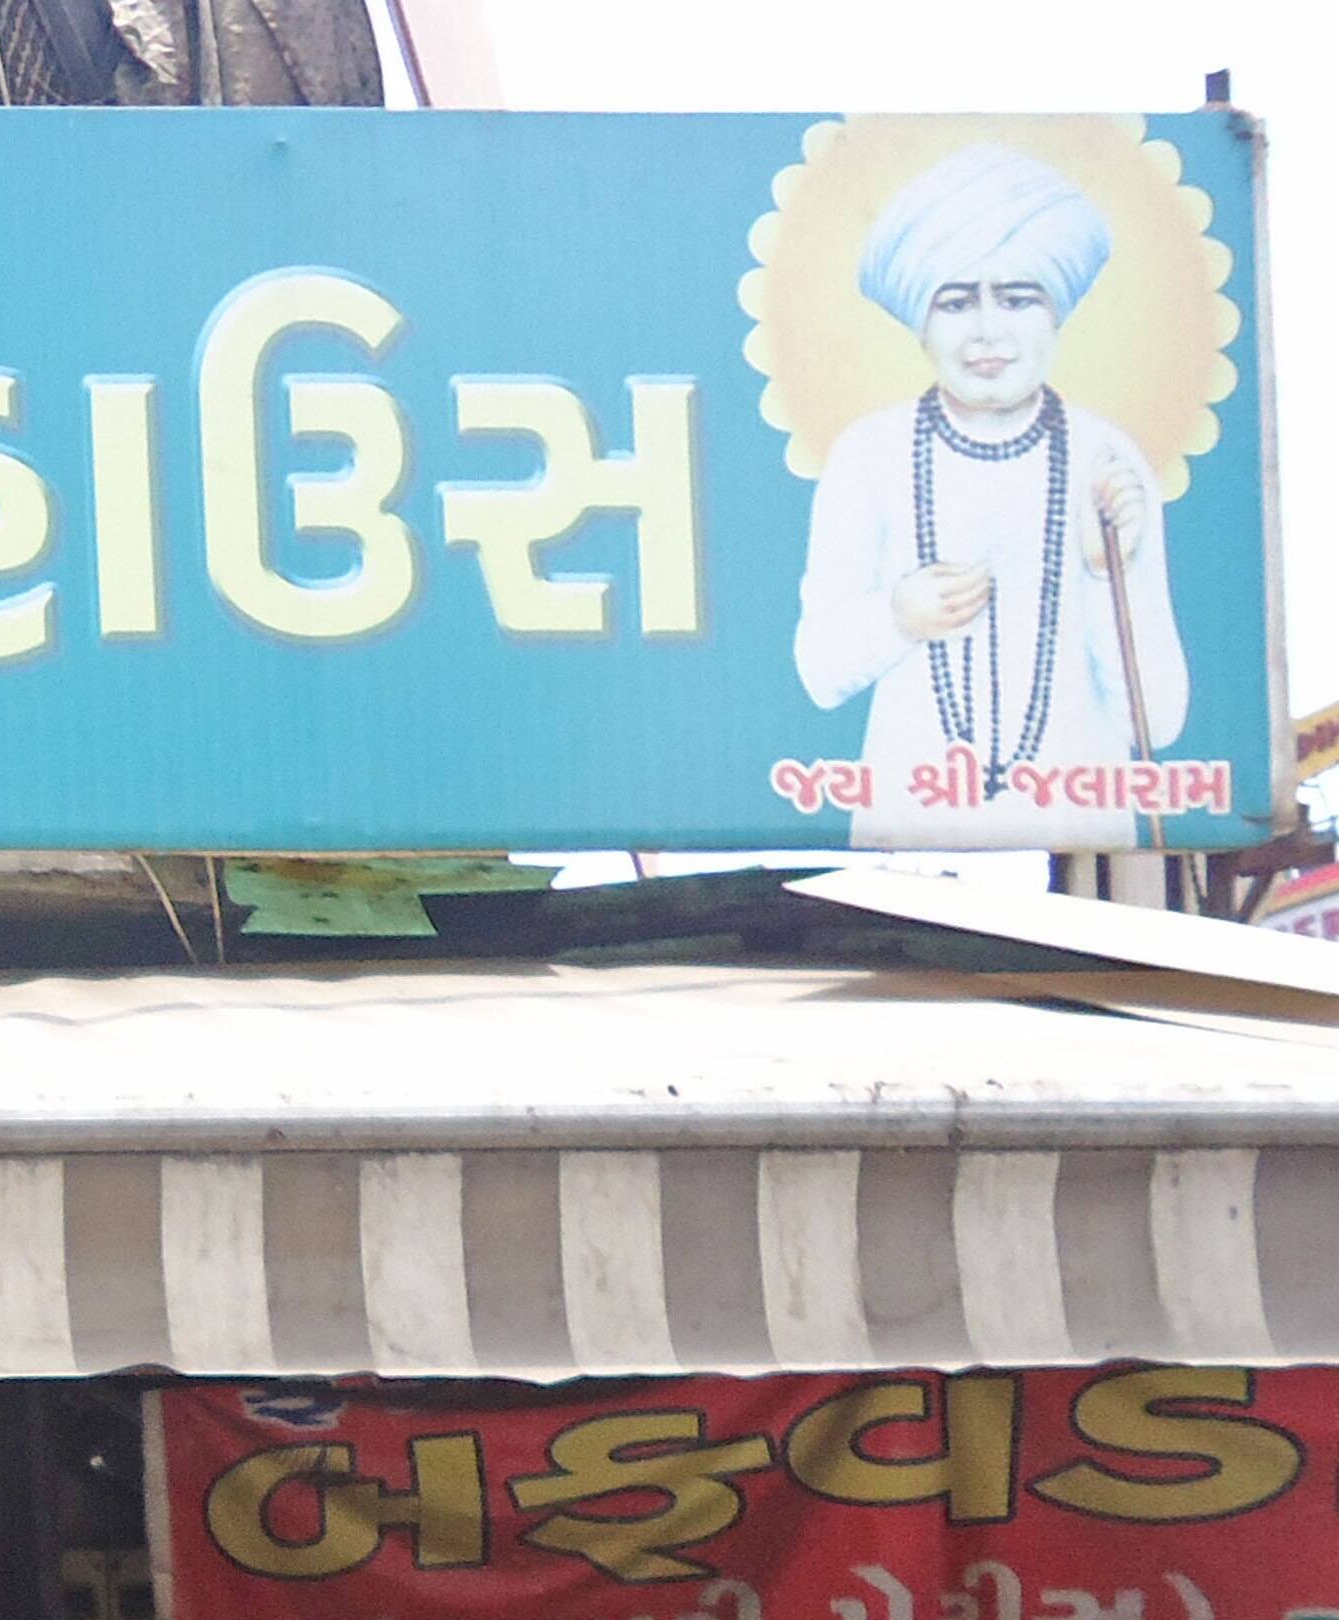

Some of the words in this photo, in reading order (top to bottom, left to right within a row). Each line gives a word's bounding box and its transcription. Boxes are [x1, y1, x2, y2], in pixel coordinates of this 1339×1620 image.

[773, 760, 875, 813] જય
[908, 741, 983, 808] શ્રી
[1010, 760, 1231, 815] જલારામ
[207, 1366, 1339, 1582] બફવડ
